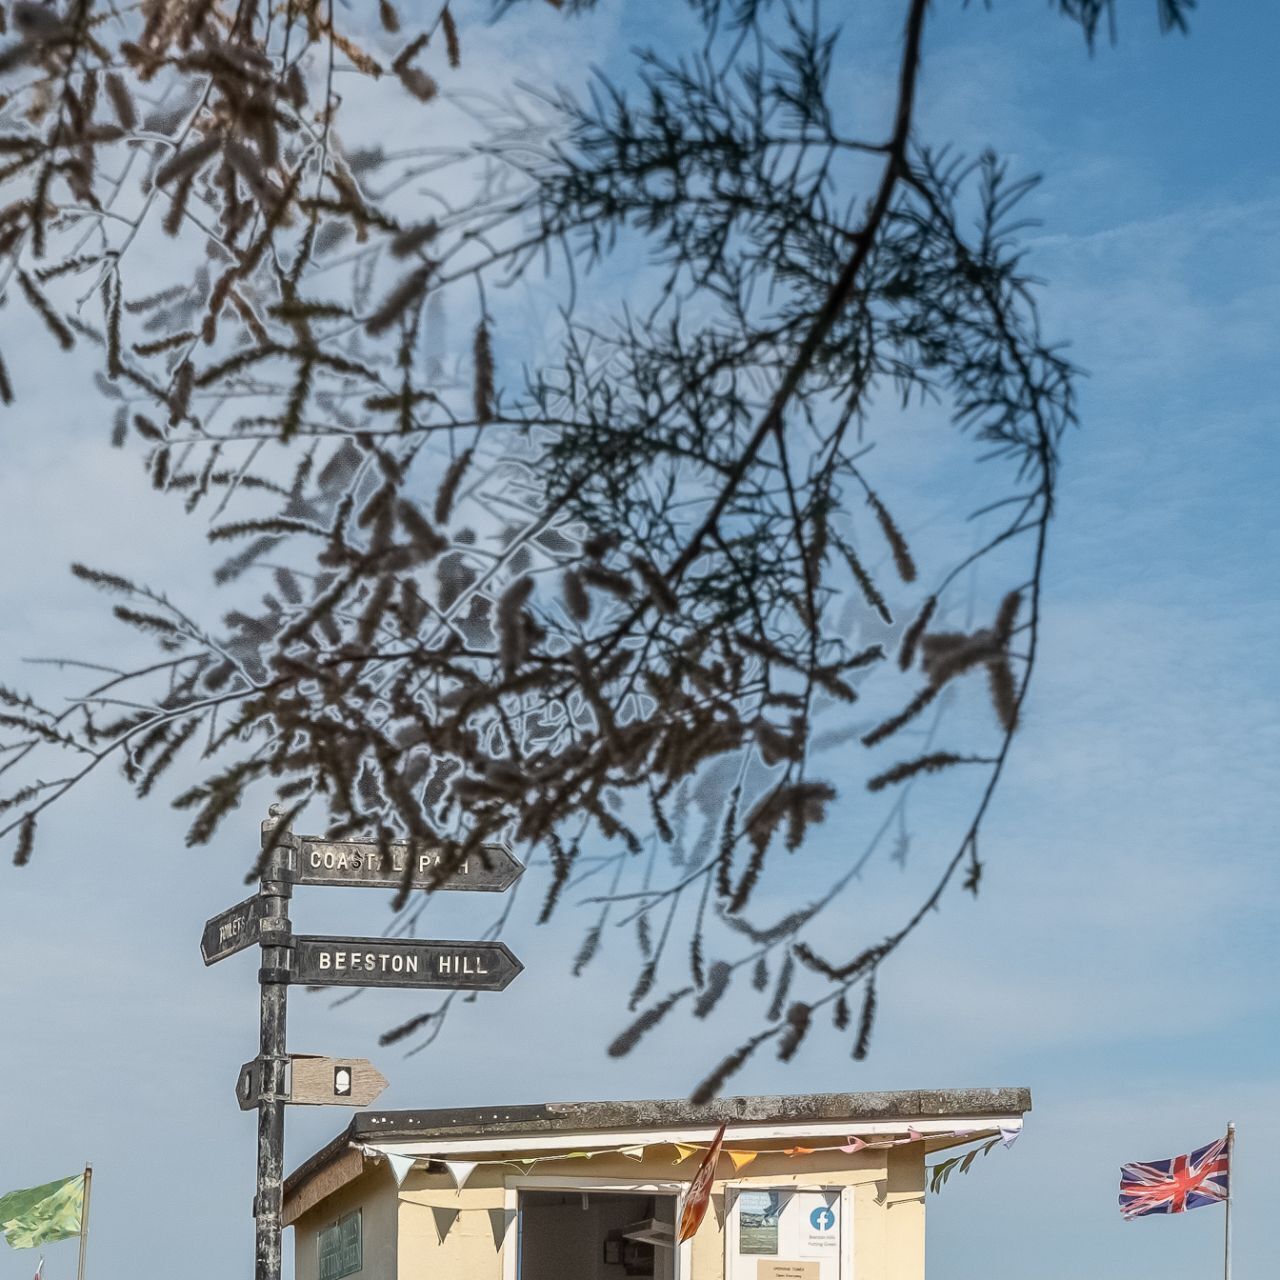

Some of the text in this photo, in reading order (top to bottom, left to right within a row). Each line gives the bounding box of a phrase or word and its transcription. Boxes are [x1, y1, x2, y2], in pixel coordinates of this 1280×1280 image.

[310, 850, 403, 872] COASTL
[319, 951, 488, 975] BEESTON HILL
